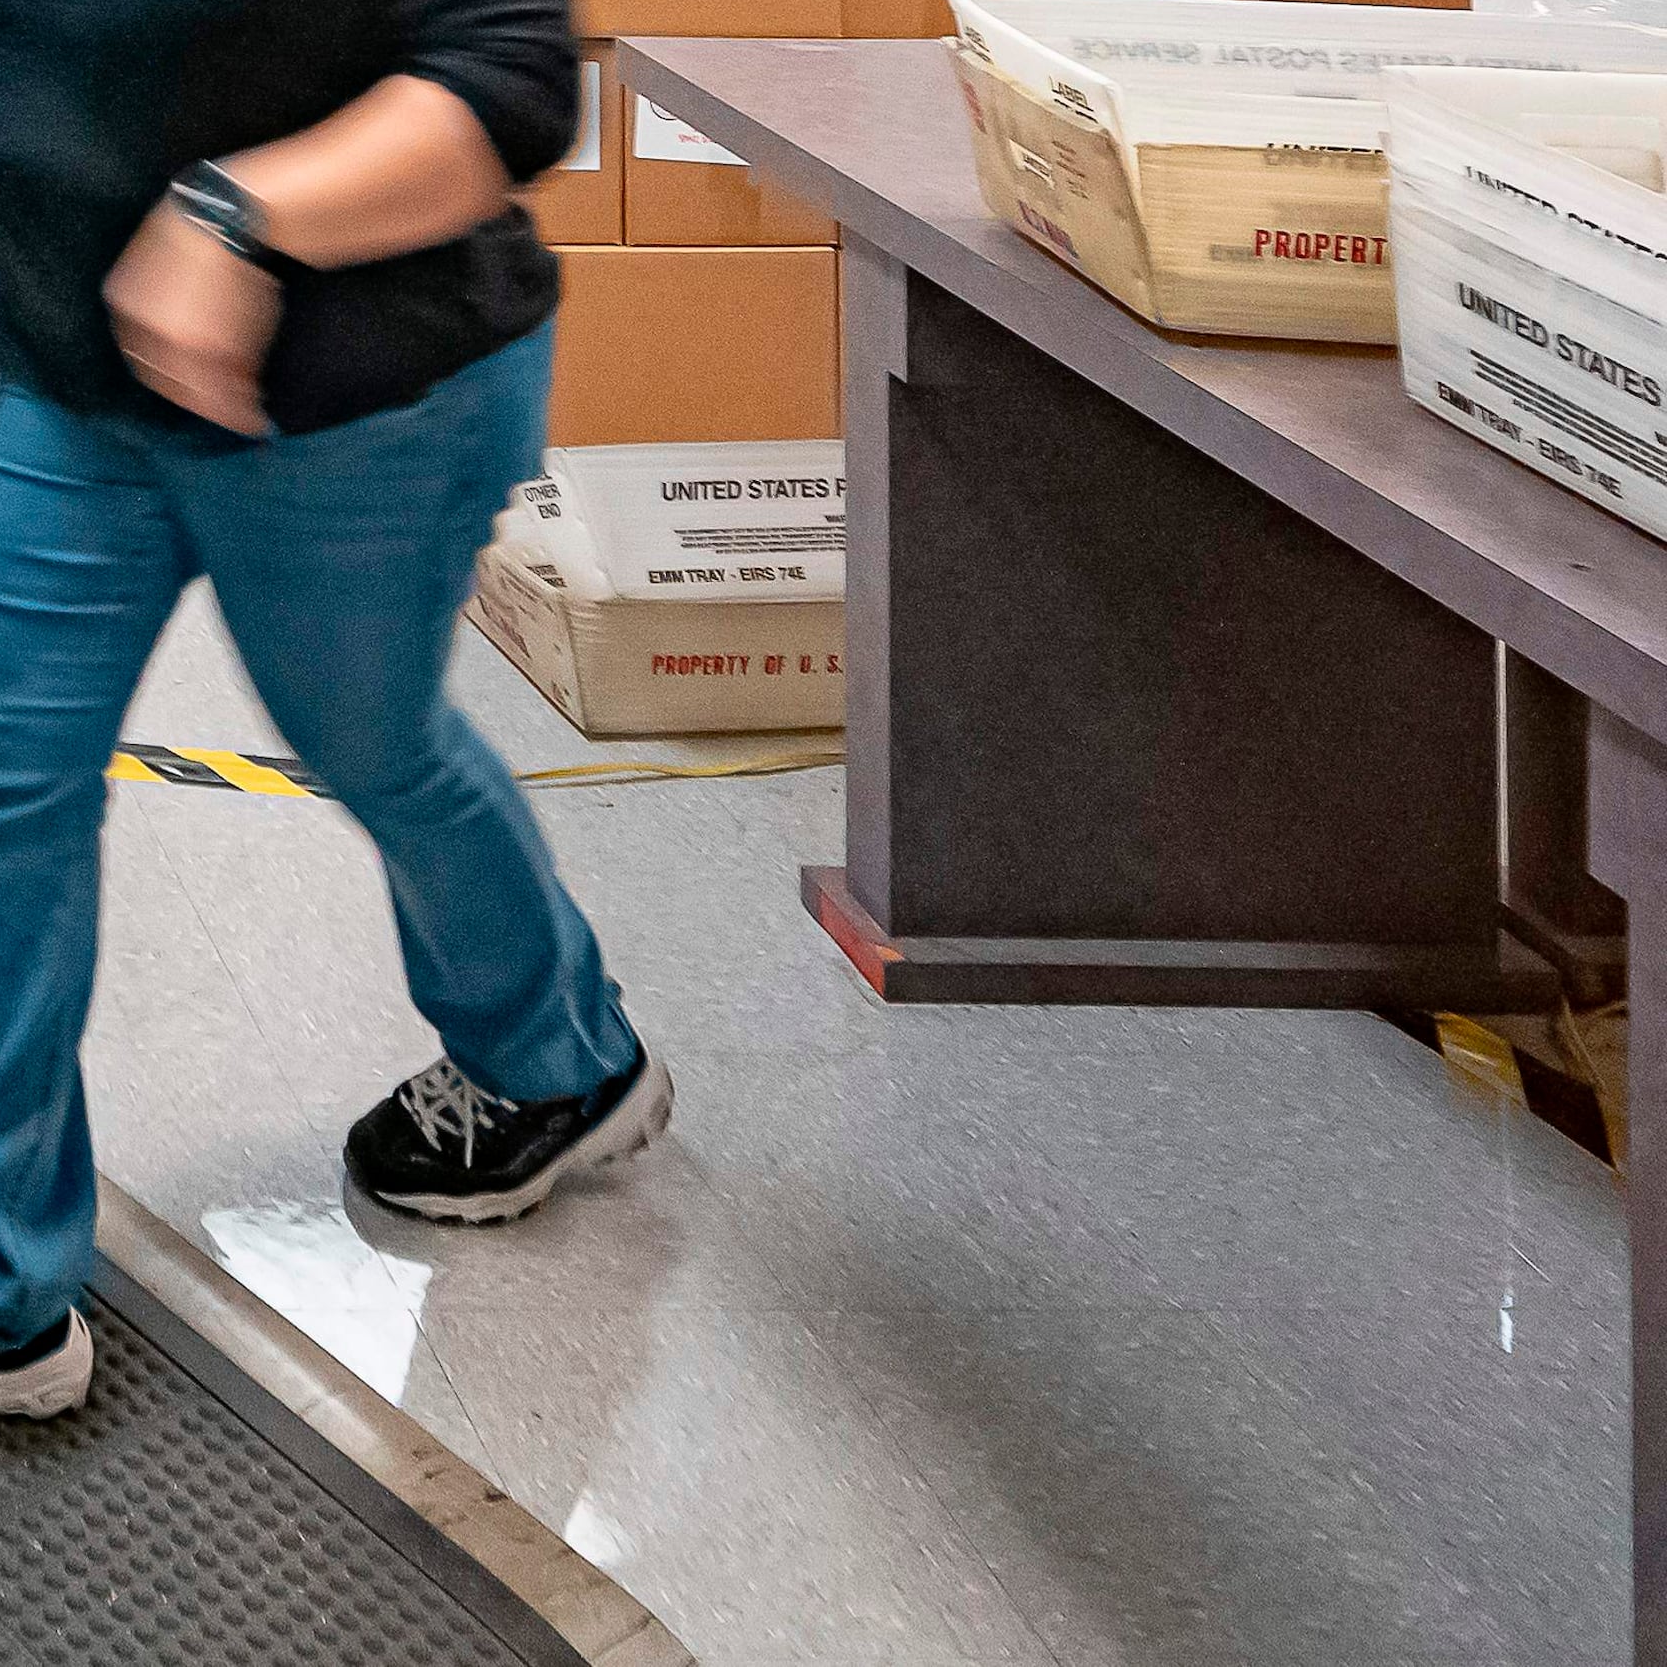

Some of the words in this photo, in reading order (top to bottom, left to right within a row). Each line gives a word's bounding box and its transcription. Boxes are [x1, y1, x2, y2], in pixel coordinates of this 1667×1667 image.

[1254, 228, 1388, 265] PROPERT
[1457, 281, 1550, 348] UNITED
[1556, 333, 1663, 407] STATES
[524, 483, 562, 503] OTHER
[661, 480, 743, 502] UNITED
[747, 477, 830, 500] STATES
[537, 503, 562, 519] END
[648, 569, 685, 584] EMM
[685, 568, 725, 583] TRAY
[739, 567, 776, 582] EIRS
[778, 566, 807, 580] 74E
[650, 653, 751, 676] PROPERTY
[764, 654, 786, 676] OF
